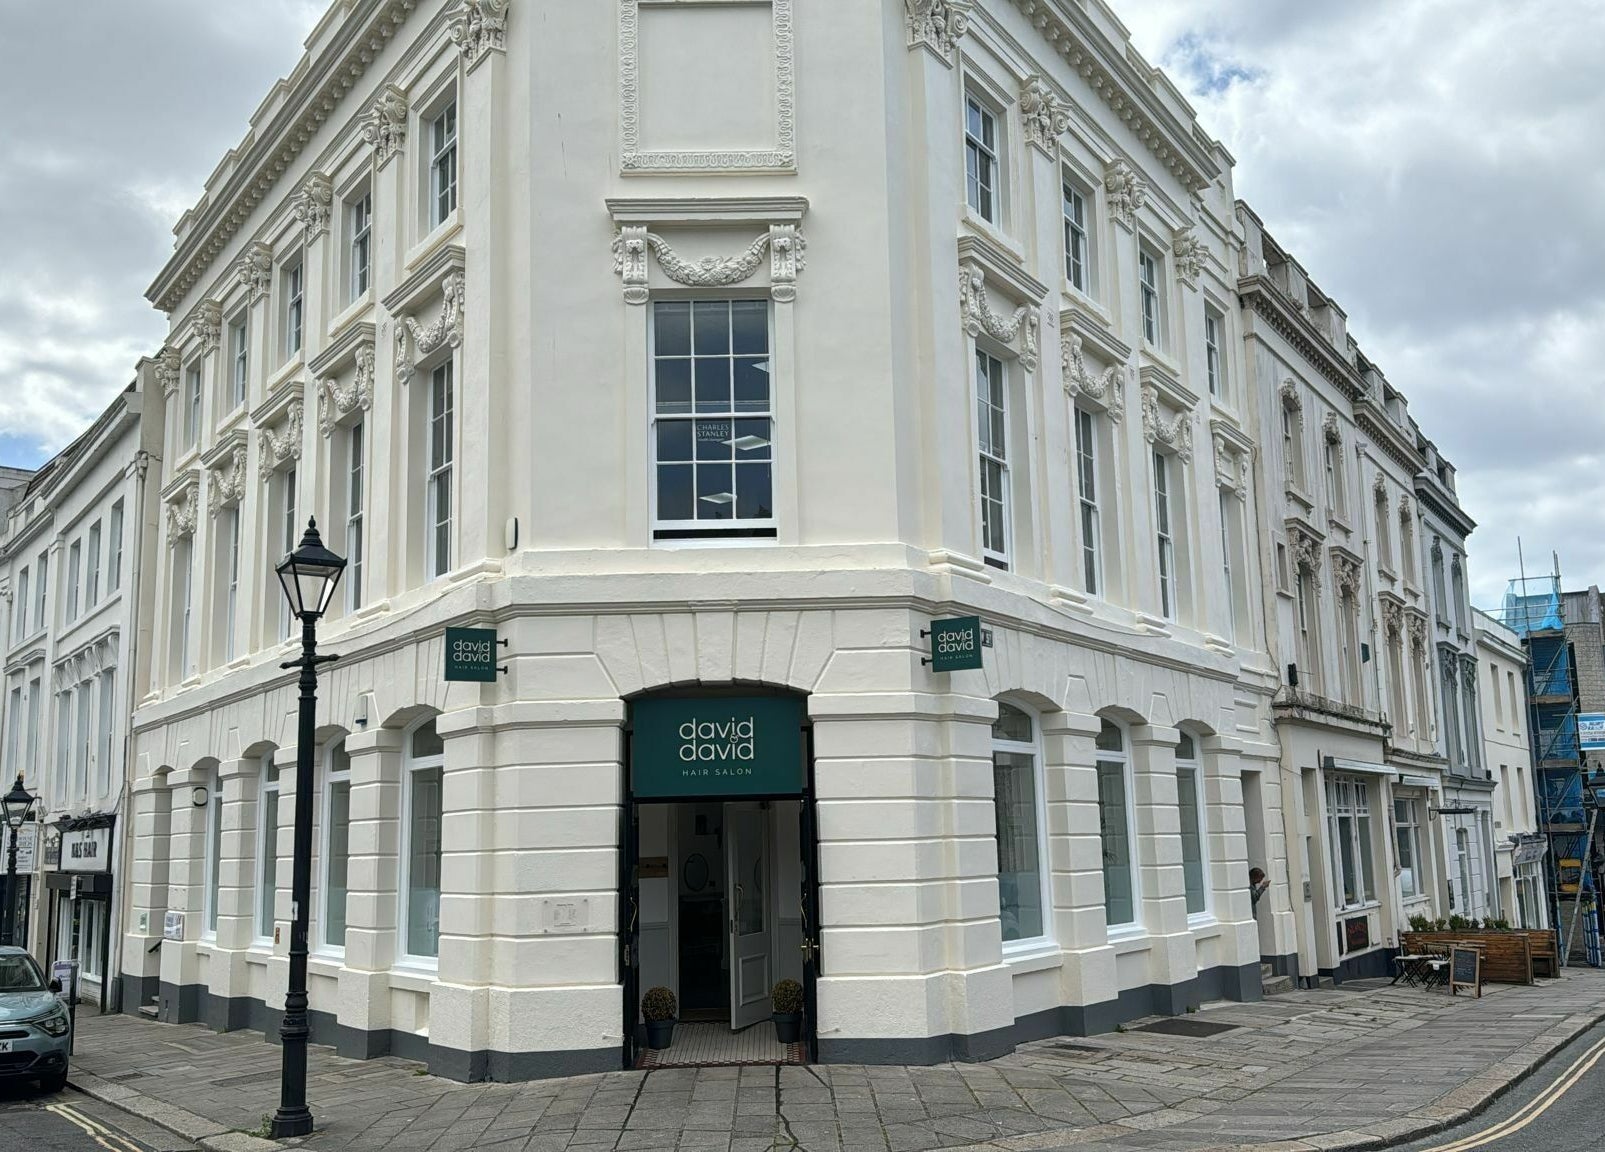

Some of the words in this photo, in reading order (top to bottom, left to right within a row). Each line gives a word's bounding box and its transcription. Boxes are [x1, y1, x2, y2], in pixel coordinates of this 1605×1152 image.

[938, 628, 973, 642] david
[453, 640, 490, 651] david
[939, 639, 974, 652] david
[453, 650, 490, 662] david
[679, 716, 753, 739] david
[680, 738, 754, 761] david
[715, 768, 752, 776] SALON
